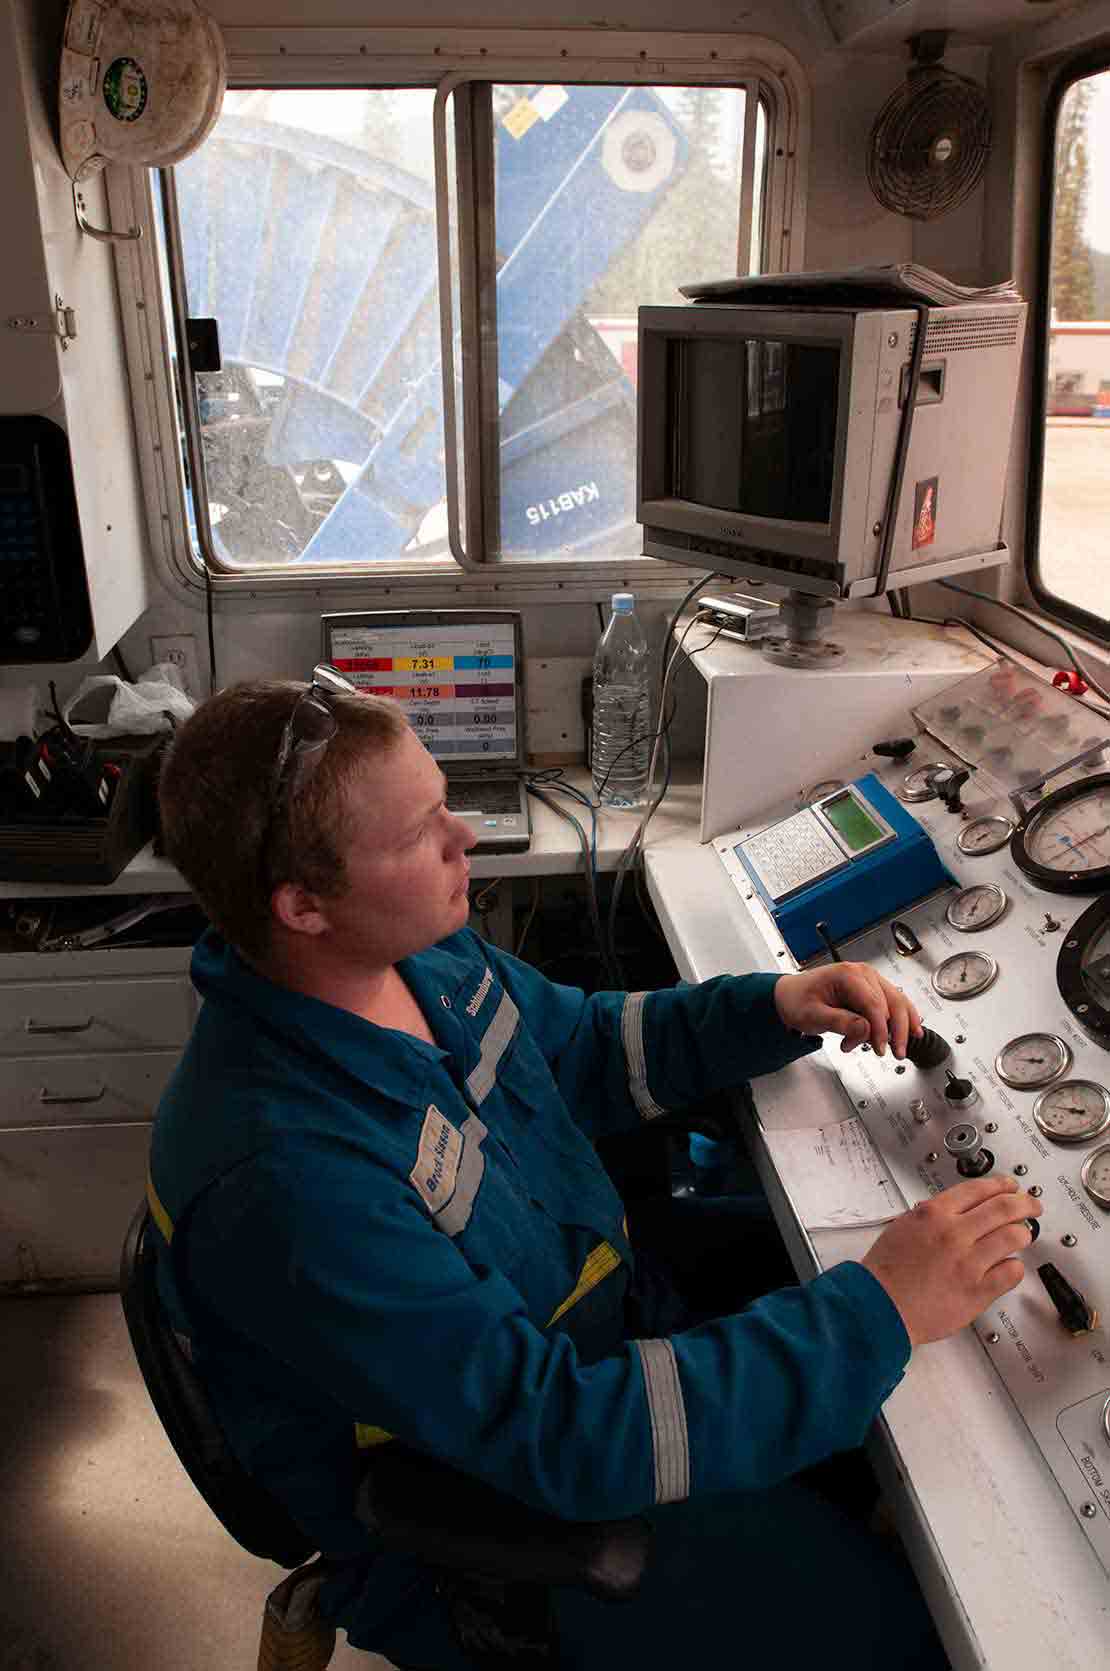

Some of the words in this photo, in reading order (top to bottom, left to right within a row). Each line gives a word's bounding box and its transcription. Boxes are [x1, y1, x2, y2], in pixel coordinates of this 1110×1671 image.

[526, 481, 600, 525] KAB115
[411, 658, 435, 669] 7.31
[409, 687, 440, 698] 11.78
[1081, 1456, 1105, 1487] BOTTOM
